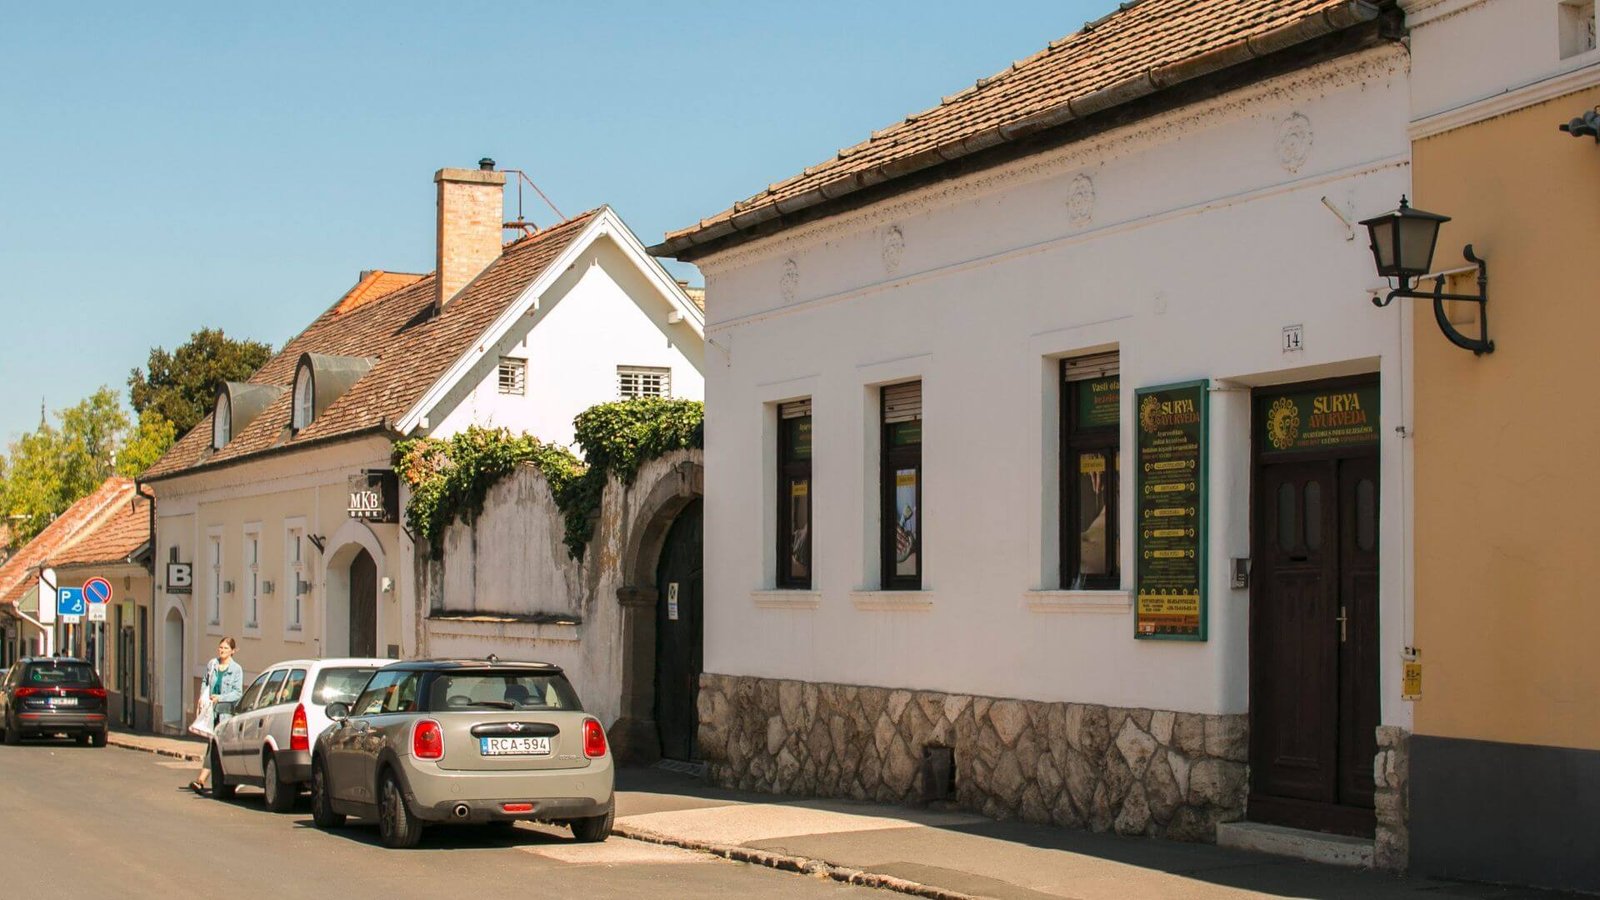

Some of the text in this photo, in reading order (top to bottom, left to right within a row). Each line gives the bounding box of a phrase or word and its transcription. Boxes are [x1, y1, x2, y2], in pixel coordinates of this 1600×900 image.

[1287, 331, 1300, 348] 14
[1161, 399, 1194, 415] SURYA
[1313, 392, 1360, 415] SURYA
[1309, 409, 1367, 428] AYURVEDA
[350, 490, 378, 510] MKB
[169, 564, 191, 587] B
[61, 590, 71, 604] P
[491, 738, 547, 751] RCA-594
